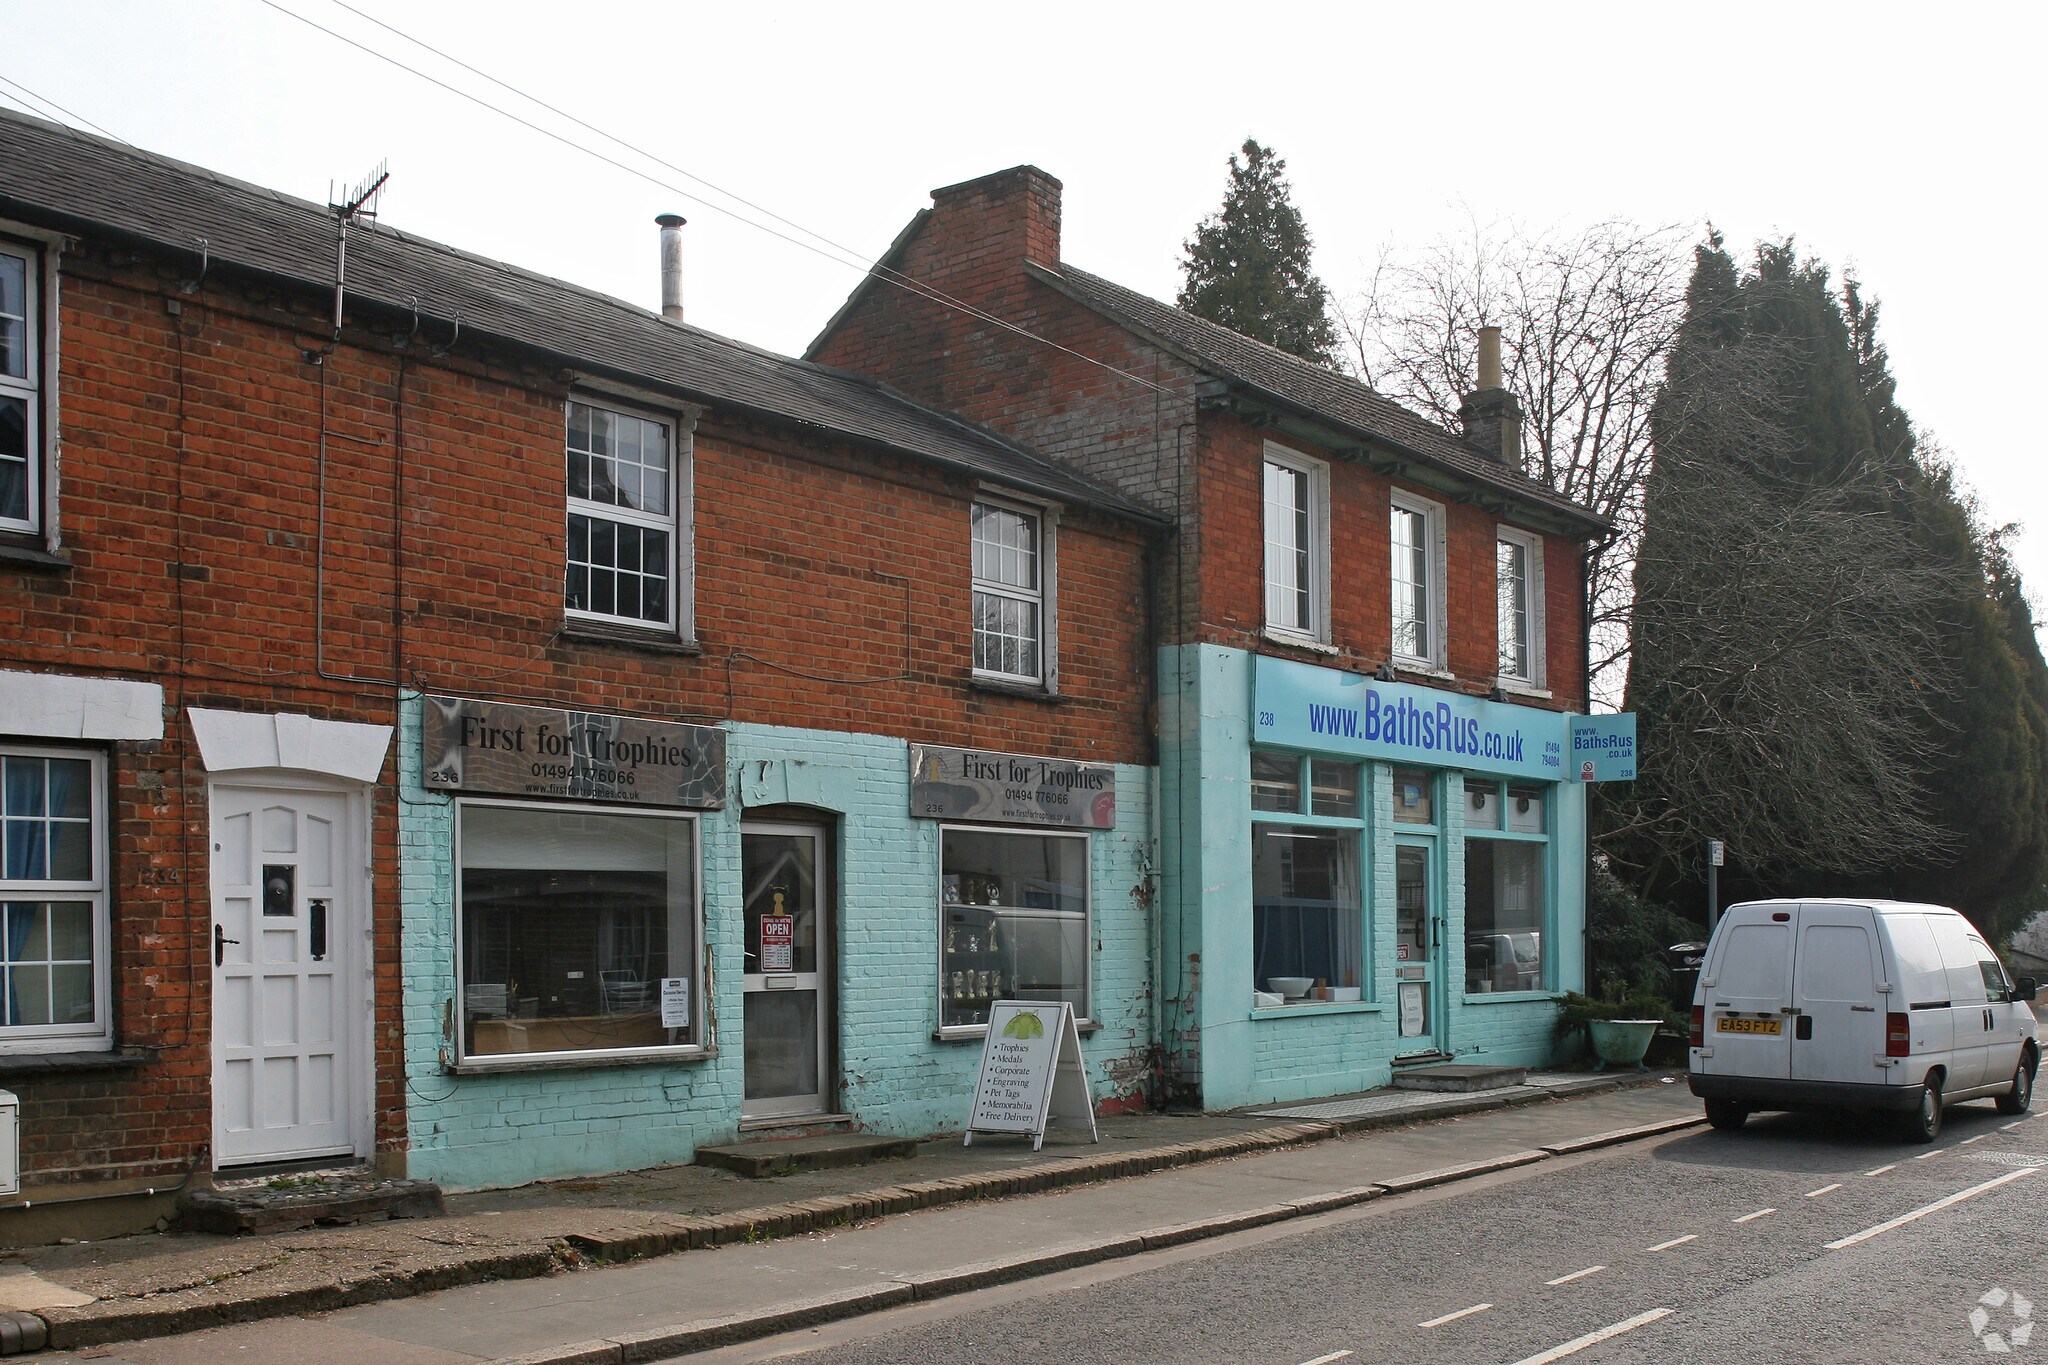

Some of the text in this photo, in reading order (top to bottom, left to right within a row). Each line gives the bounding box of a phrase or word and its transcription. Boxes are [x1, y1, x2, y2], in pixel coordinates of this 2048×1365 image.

[1259, 711, 1274, 727] 238
[1309, 689, 1523, 763] www.BathsRus.co.uk
[1574, 728, 1599, 736] www.
[459, 715, 691, 768] First for Trophies
[1574, 735, 1633, 750] BathsRus
[1606, 748, 1633, 758] .co.uk
[431, 771, 459, 784] 236
[532, 763, 635, 785] 01494 776066
[962, 753, 1103, 792] First for Trophies
[1620, 770, 1633, 778] 238
[525, 782, 640, 801] www.firstfortrophies.co.uk
[1005, 788, 1069, 805] 01494 776066
[926, 803, 944, 814] 236
[766, 923, 789, 935] OPEN
[1397, 950, 1407, 958] PEN
[1721, 1019, 1777, 1033] EA53 FTZ
[1000, 1043, 1029, 1053] Trophies
[997, 1054, 1023, 1063] Medals
[994, 1066, 1030, 1075] Corporate
[992, 1077, 1029, 1088] Engraving
[990, 1089, 1021, 1099] Pet Tags
[987, 1100, 1032, 1110] Memorabilia
[985, 1111, 1035, 1123] Free Delivery
